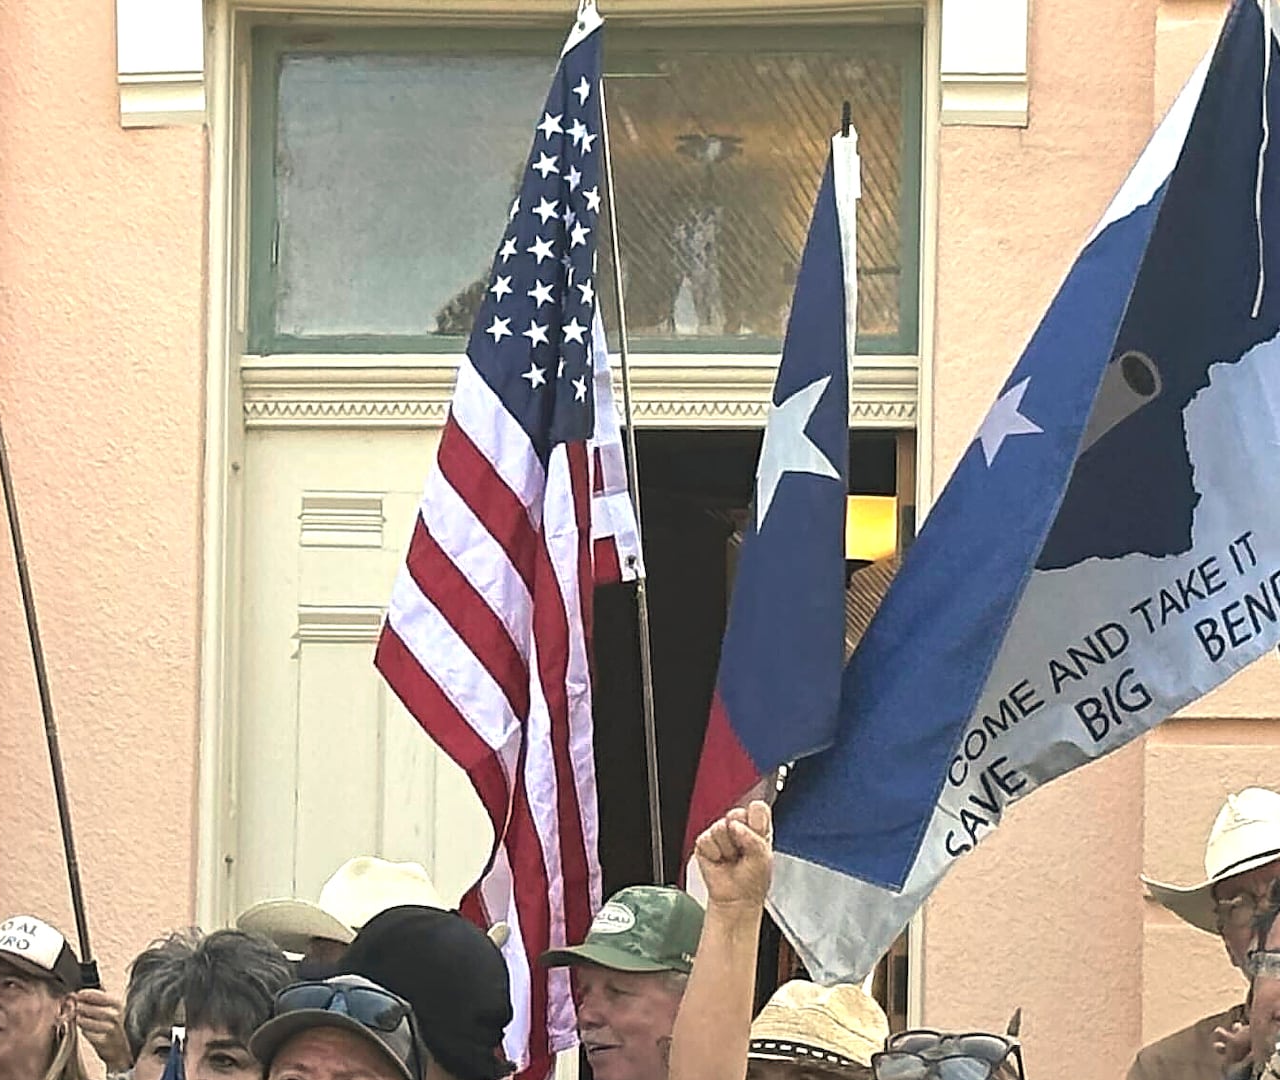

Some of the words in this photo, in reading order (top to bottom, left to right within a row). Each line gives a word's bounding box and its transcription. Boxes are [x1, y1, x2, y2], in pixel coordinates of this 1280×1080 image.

[945, 756, 1028, 859] SAVE
[1075, 666, 1153, 744] BIG
[947, 679, 1044, 788] COME
[1049, 621, 1130, 695] AND
[1131, 556, 1227, 635] TAKE
[1230, 531, 1260, 577] IT
